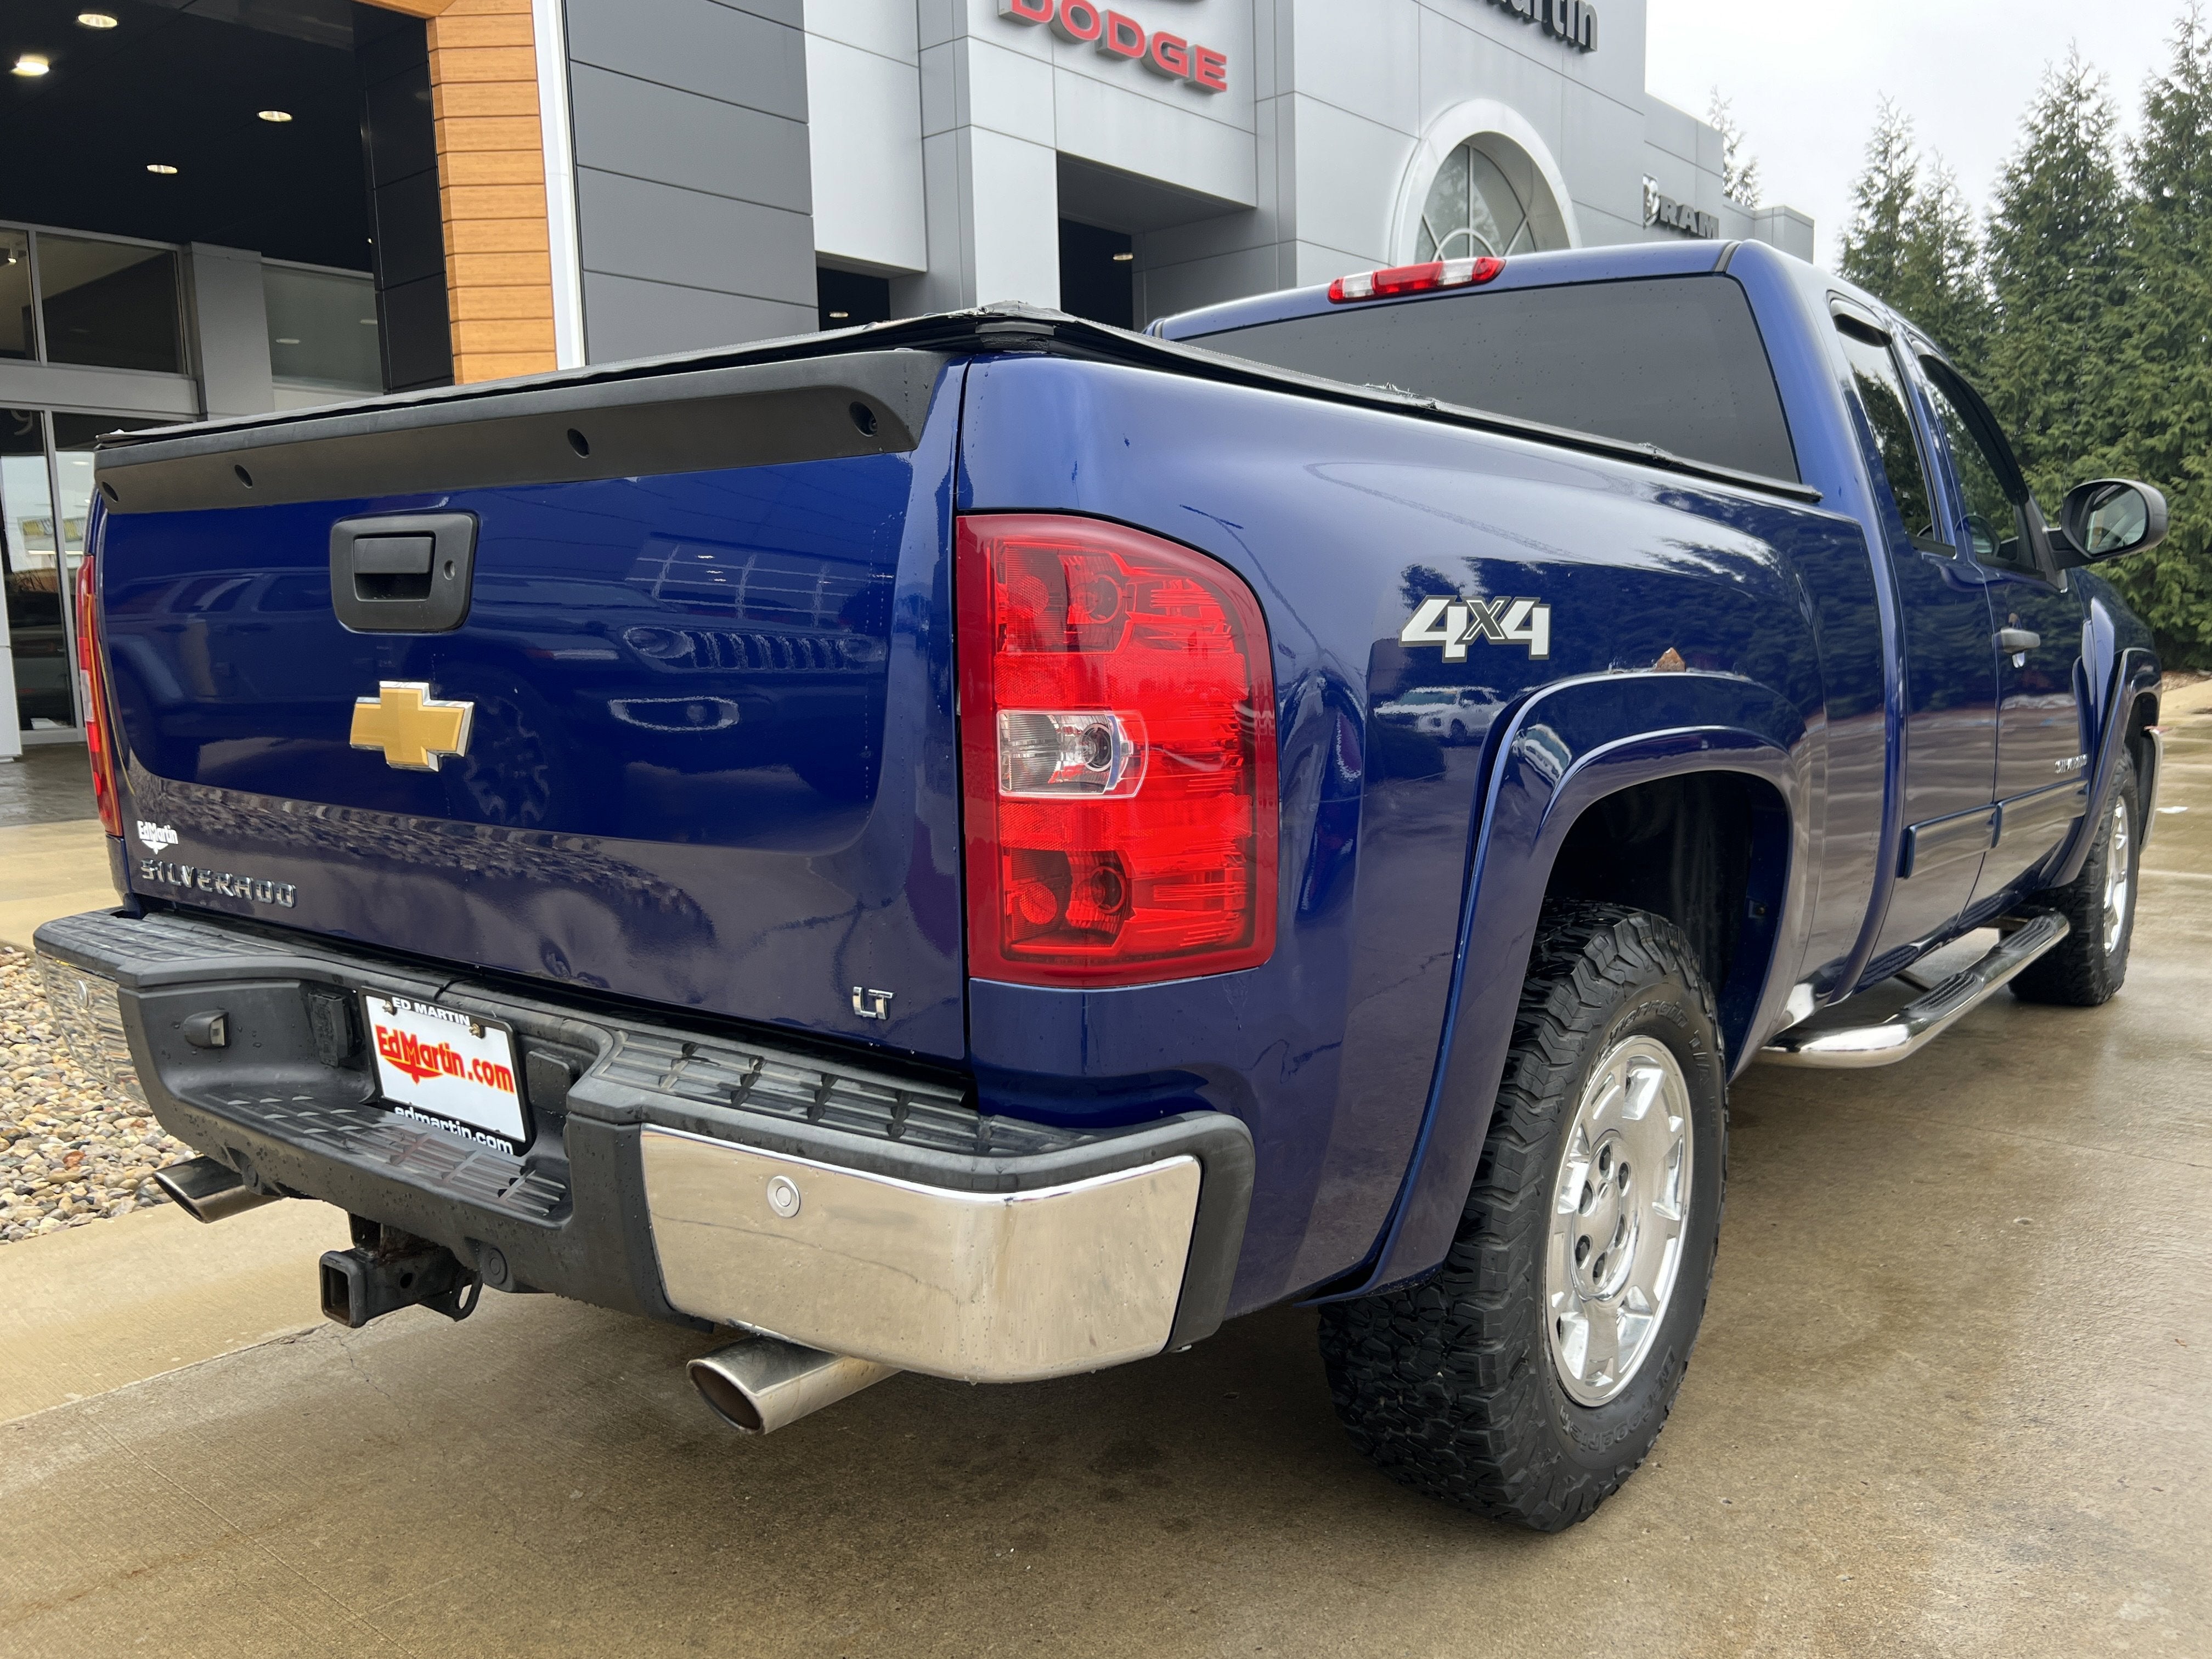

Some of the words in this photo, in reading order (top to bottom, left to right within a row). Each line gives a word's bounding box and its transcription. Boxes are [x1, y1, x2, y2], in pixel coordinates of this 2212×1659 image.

[1484, 0, 1598, 52] tin
[1659, 194, 1719, 240] RAM
[141, 858, 297, 908] SILVERADO
[392, 996, 411, 1011] ED
[414, 1002, 471, 1026] MARTIN
[853, 986, 895, 1020] LT
[375, 1024, 516, 1095] EdMartin.com
[394, 1106, 514, 1155] edmartin.com
